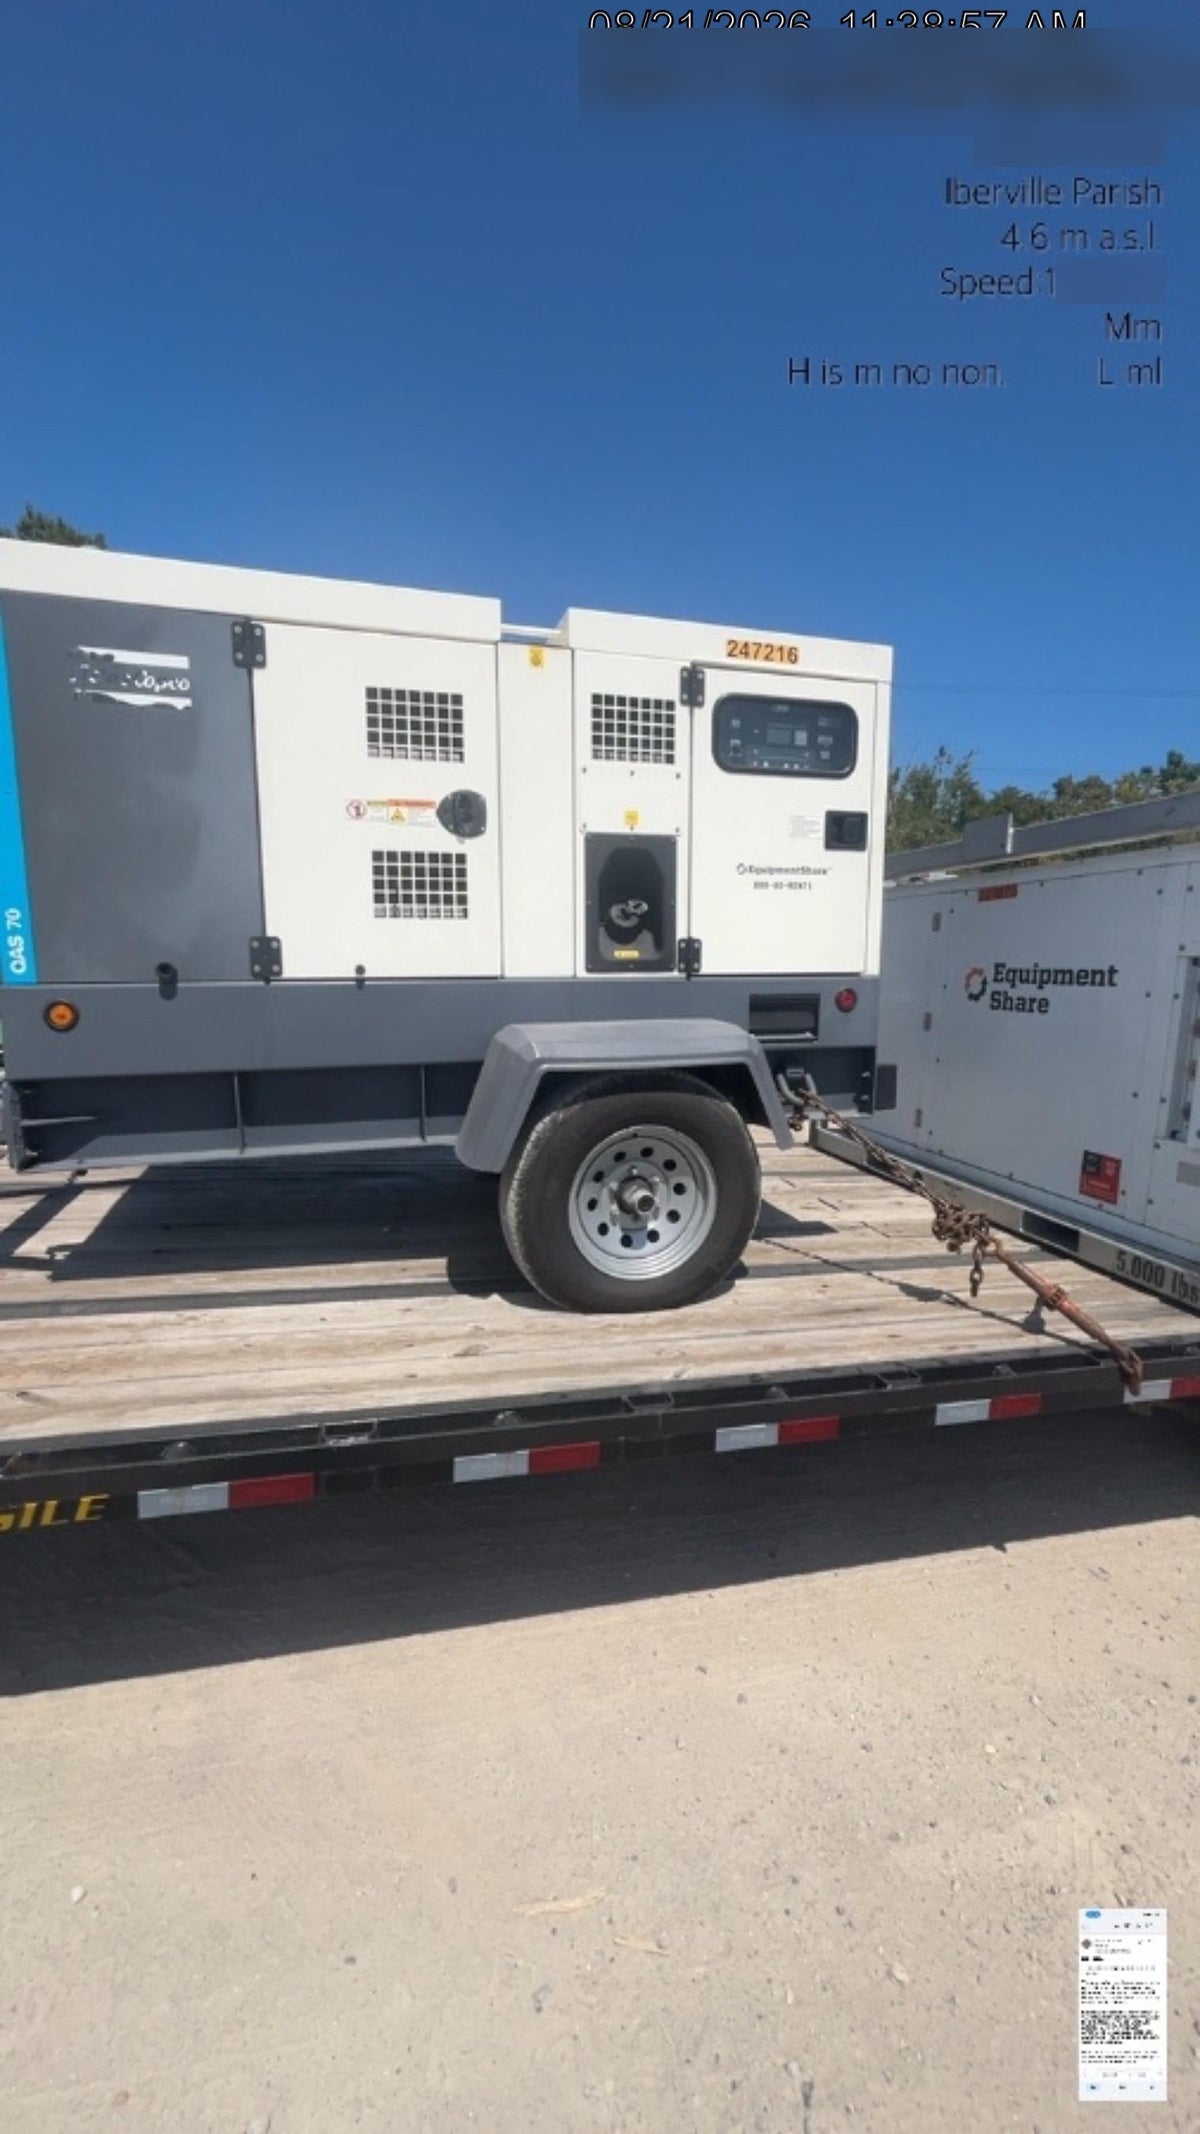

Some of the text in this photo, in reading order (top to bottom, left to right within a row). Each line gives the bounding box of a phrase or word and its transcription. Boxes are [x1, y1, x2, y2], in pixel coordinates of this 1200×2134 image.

[727, 639, 799, 665] 247216
[5, 907, 27, 975] QAS 70
[993, 961, 1118, 990] Equipment
[989, 990, 1050, 1014] Share
[1171, 1270, 1199, 1304] lbs
